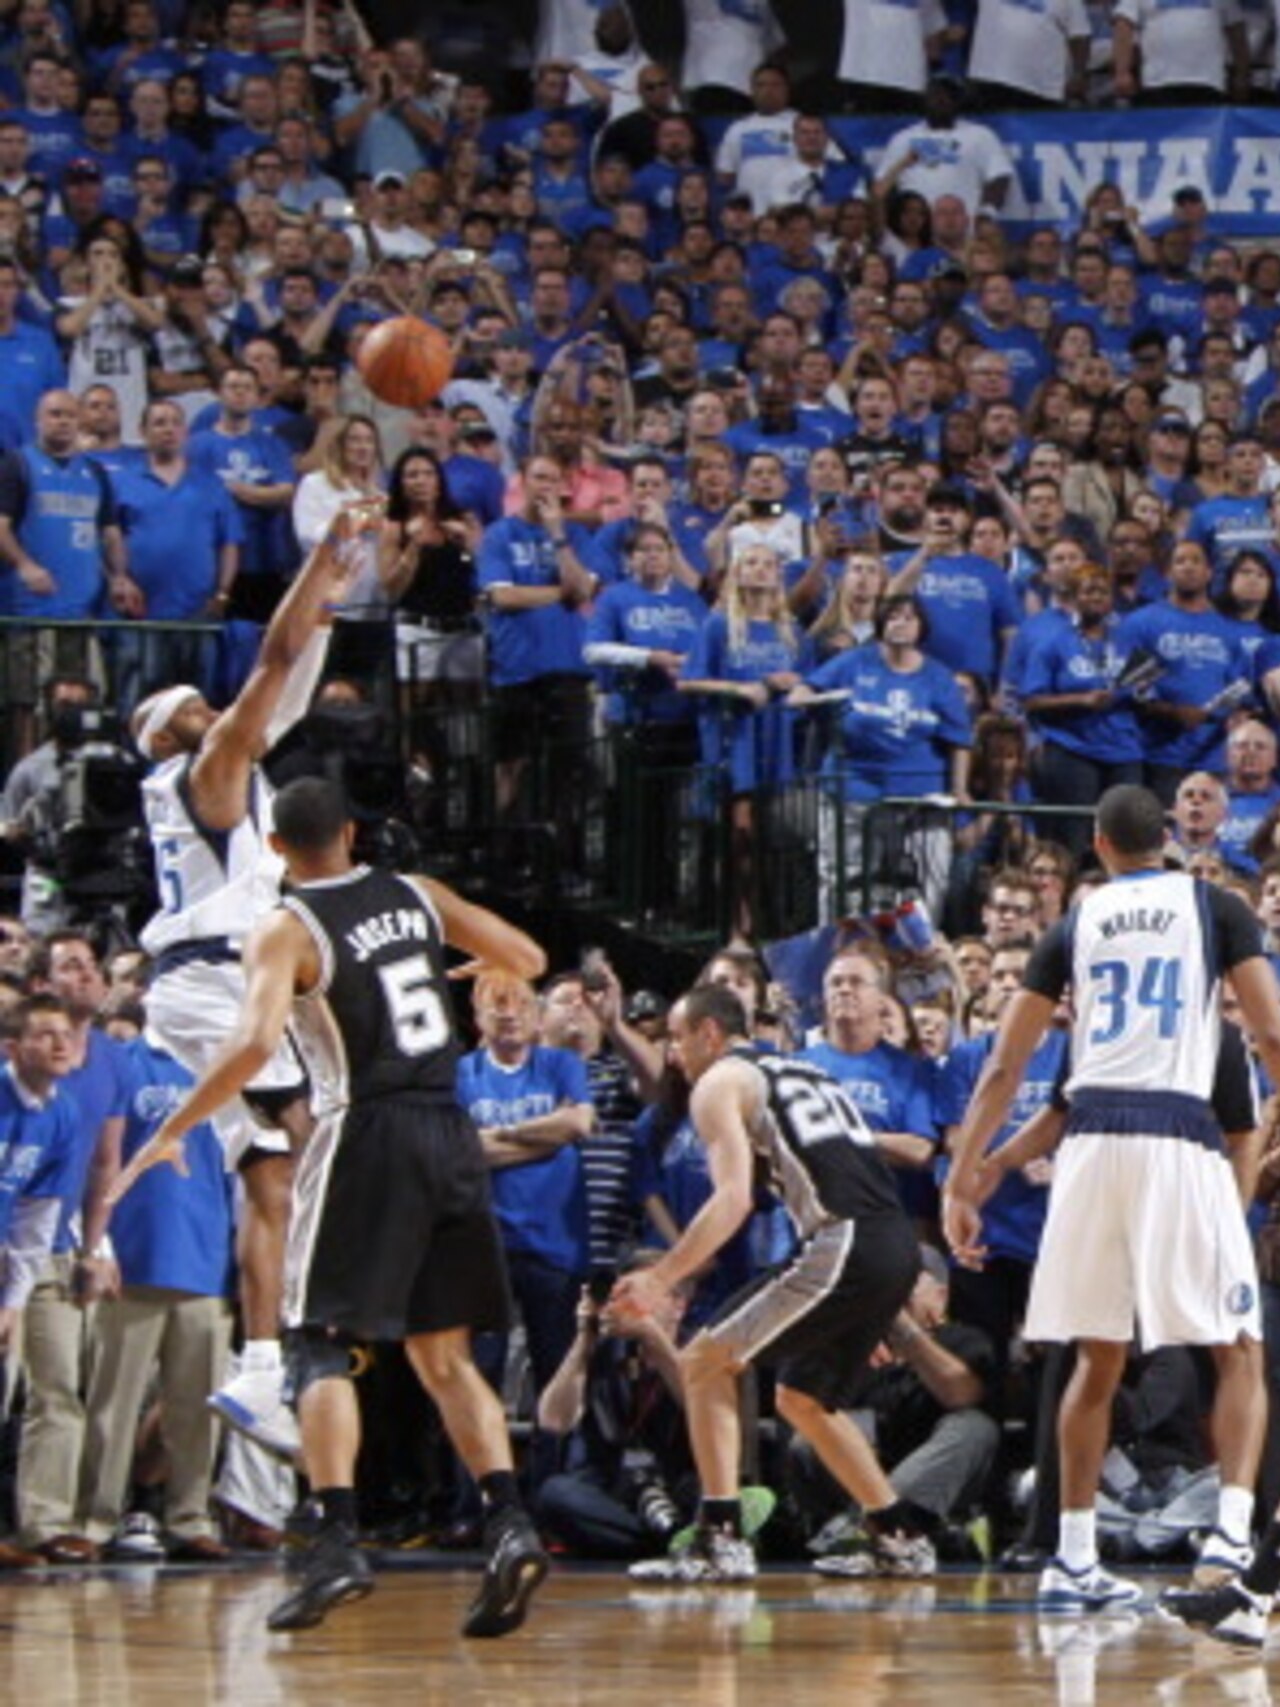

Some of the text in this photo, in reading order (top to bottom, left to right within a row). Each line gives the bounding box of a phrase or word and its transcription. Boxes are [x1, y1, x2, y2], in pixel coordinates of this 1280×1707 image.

[345, 908, 429, 962] JOSEPH
[1098, 908, 1177, 939] WRIGHT
[377, 952, 451, 1058] 5
[1089, 956, 1183, 1044] 34
[776, 1076, 877, 1148] 20
